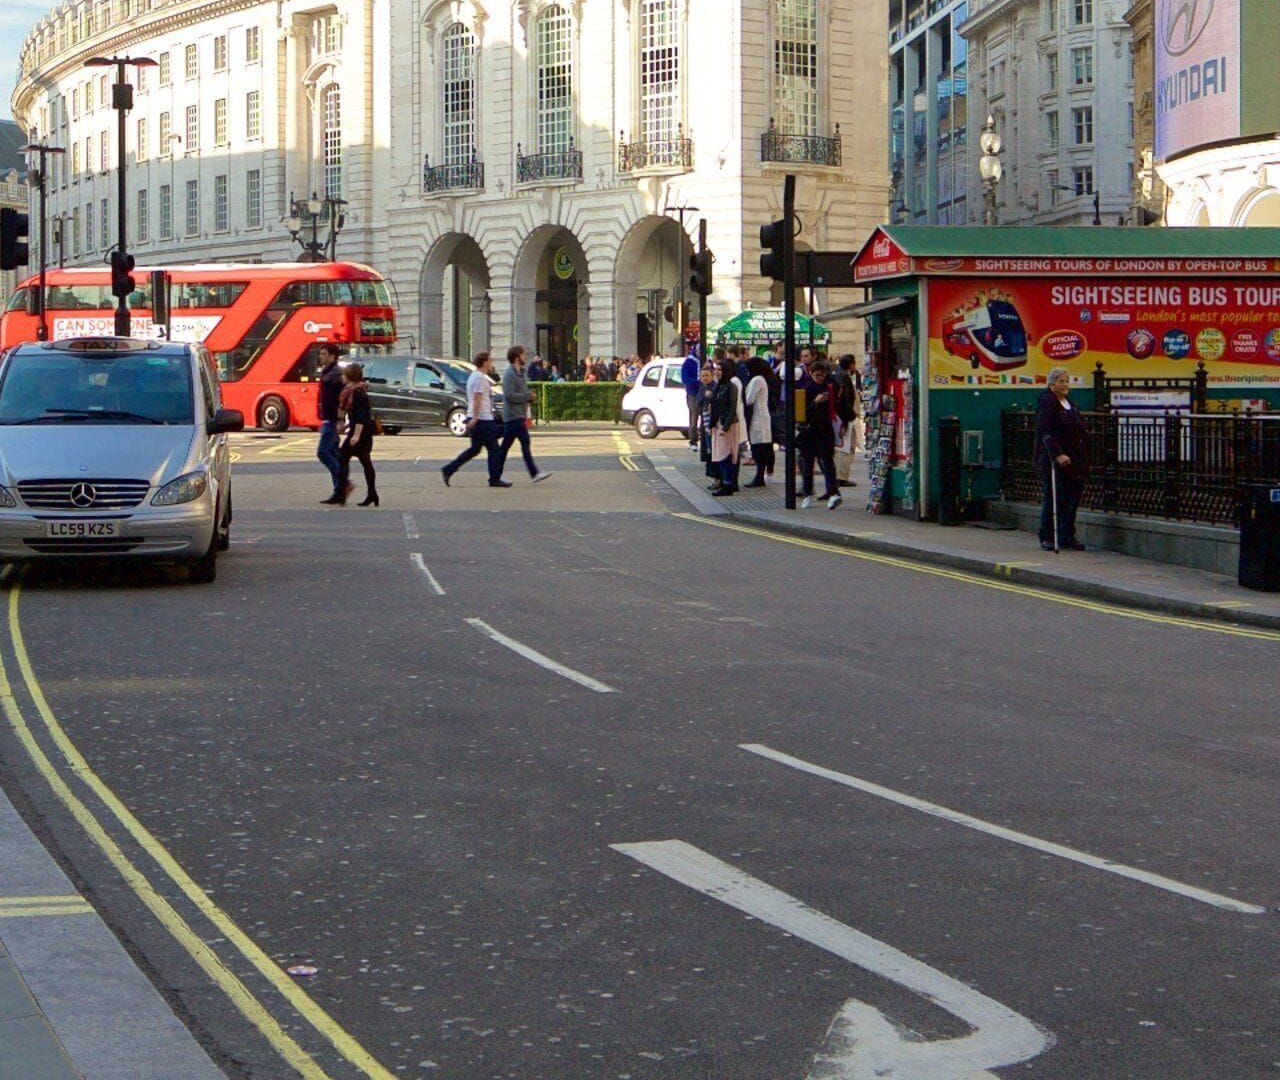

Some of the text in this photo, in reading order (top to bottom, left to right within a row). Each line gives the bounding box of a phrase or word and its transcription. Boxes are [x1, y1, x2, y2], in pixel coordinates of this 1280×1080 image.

[1157, 56, 1226, 116] HYUNDAI
[975, 260, 1267, 271] SIGHTSEEING TOURS OF LONDON BY OPEN-TOP BUS
[1051, 286, 1182, 306] SIGHTSEEING
[1188, 286, 1227, 306] BUS
[1136, 309, 1186, 321] London's
[1189, 311, 1217, 321] most
[1221, 311, 1265, 324] popular
[56, 320, 153, 331] CAN SOMONE
[1047, 335, 1079, 345] OFFICIAL
[1052, 342, 1077, 351] AGENT
[51, 523, 113, 535] LC59 KZS
